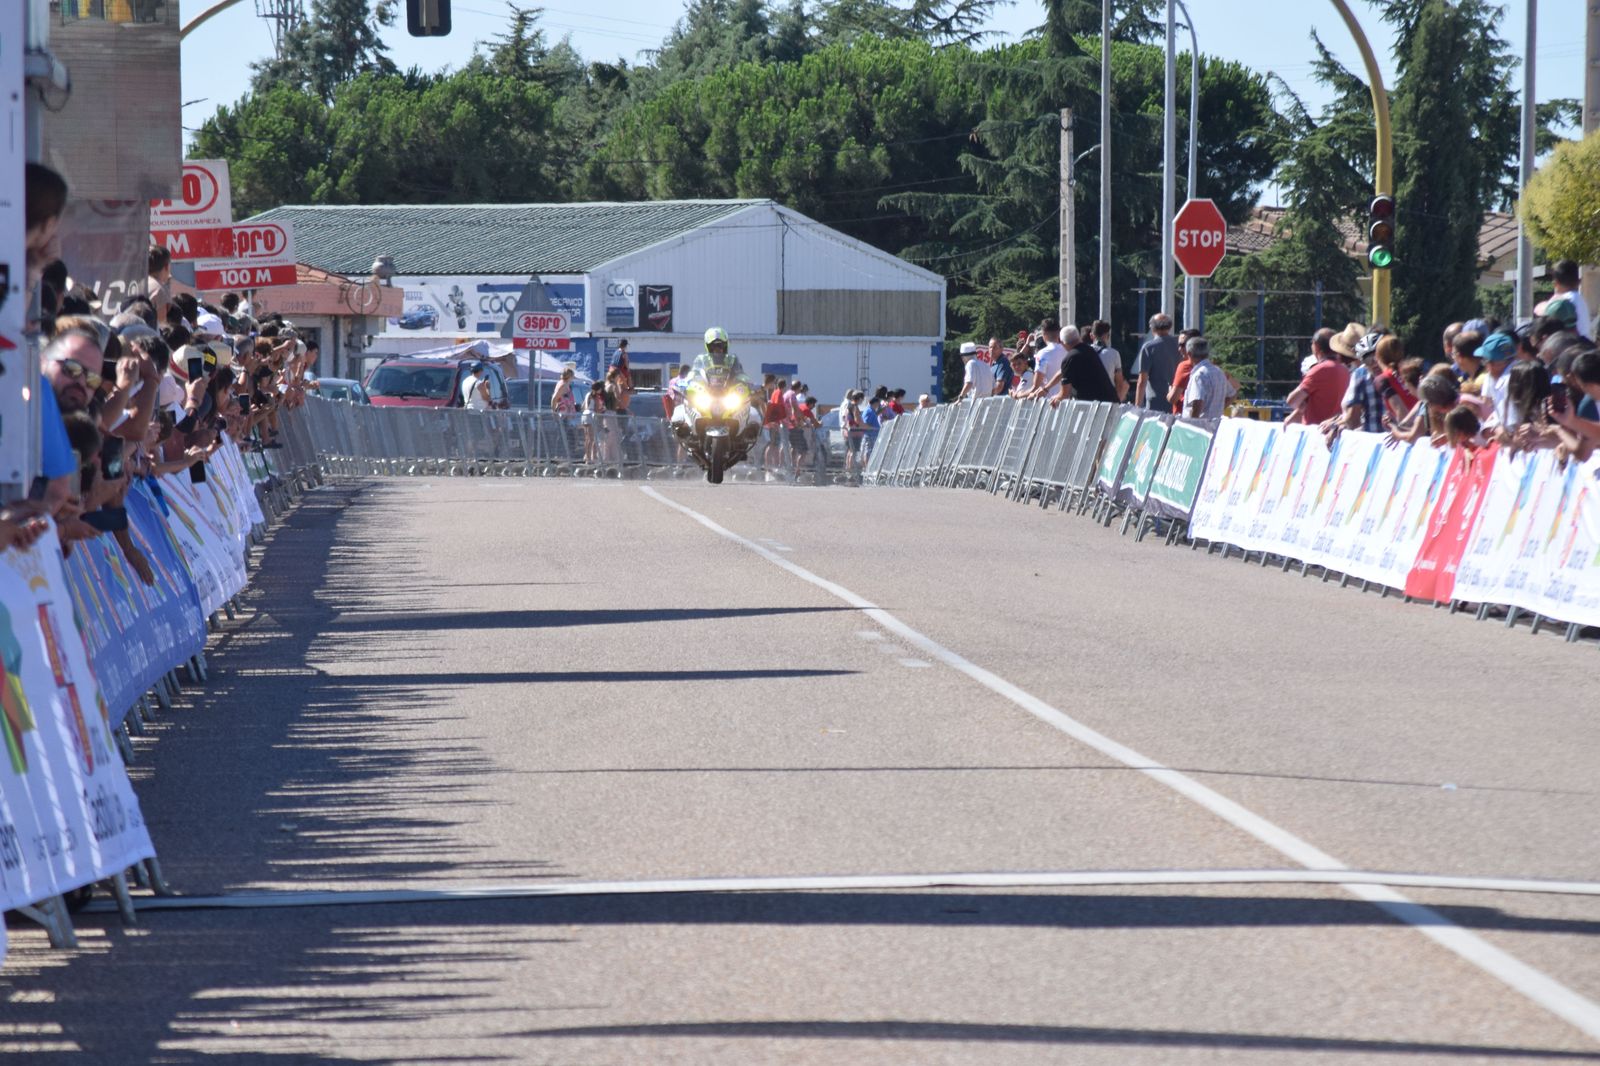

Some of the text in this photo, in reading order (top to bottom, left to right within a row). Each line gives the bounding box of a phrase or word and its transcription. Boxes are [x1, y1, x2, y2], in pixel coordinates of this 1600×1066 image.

[166, 233, 190, 254] M
[1178, 229, 1222, 248] STOP
[220, 269, 272, 286] 100 M
[524, 316, 561, 332] aspro
[526, 338, 558, 348] 200 M
